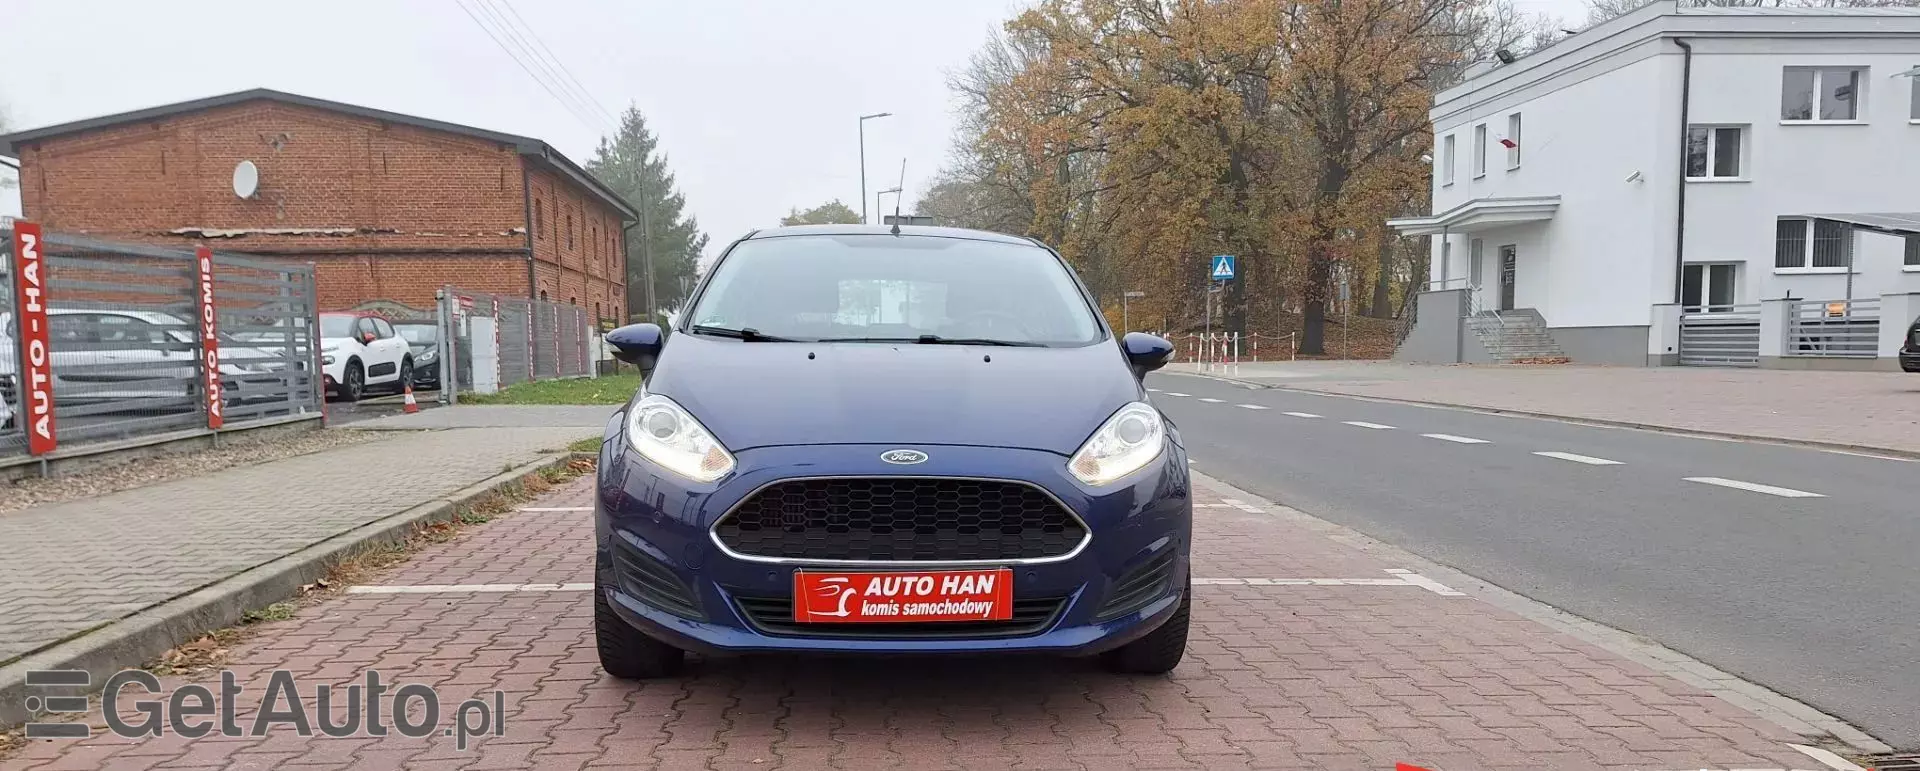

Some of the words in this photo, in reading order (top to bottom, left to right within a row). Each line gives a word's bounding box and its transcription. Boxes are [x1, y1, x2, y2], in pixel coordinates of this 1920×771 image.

[21, 233, 41, 312] HAN
[201, 257, 215, 340] KOMIS
[30, 339, 51, 440] AUTO
[207, 350, 220, 416] AUTO
[891, 452, 918, 461] Ford
[861, 600, 899, 616] komis
[902, 598, 993, 618] samochodowy
[864, 576, 935, 597] AUTO
[940, 574, 996, 596] HAN
